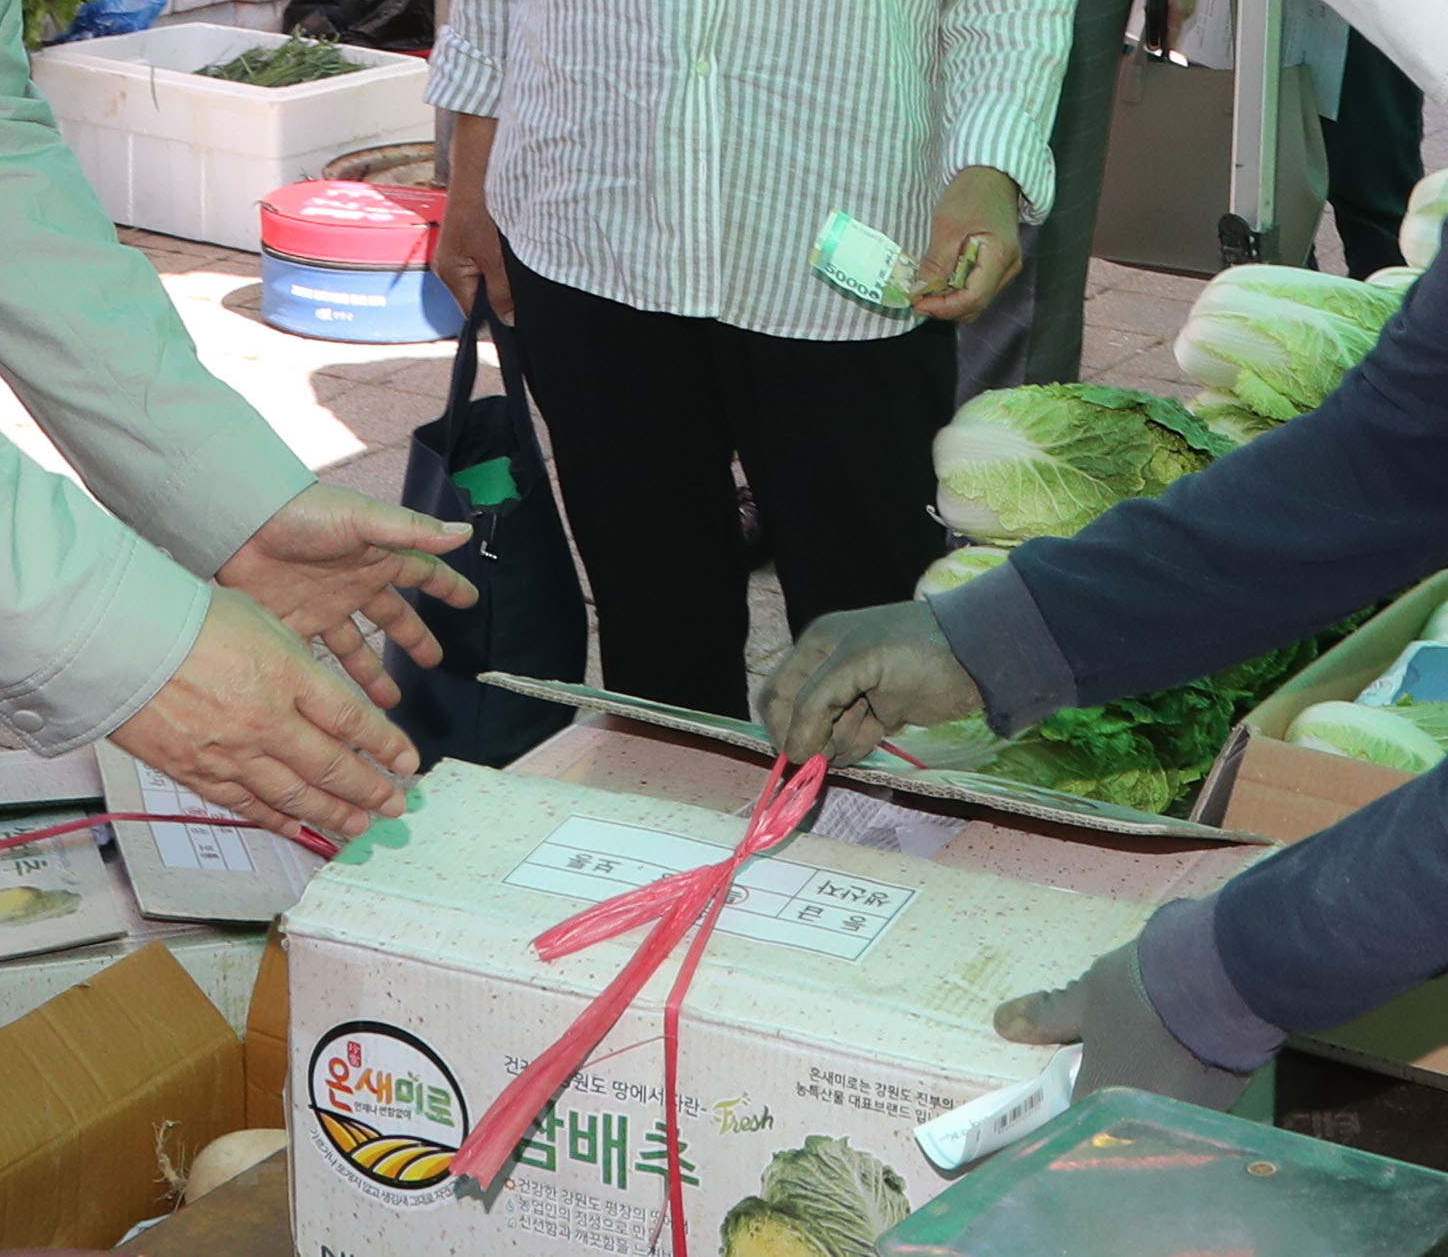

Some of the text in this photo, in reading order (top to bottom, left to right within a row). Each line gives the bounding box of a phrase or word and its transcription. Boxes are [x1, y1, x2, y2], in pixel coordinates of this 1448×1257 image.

[566, 852, 621, 874] 보통
[817, 879, 892, 909] 생산자
[325, 1057, 455, 1128] 온새미로
[561, 1070, 607, 1095] 원도
[612, 1080, 665, 1106] 땅에서
[795, 1081, 844, 1106] 농특산물
[848, 1093, 912, 1119] 대표브랜드
[808, 1066, 954, 1110] 온새미로는 강원도 진부의
[354, 1101, 412, 1121] 언제나 변함없이
[712, 1092, 774, 1135] Fresh
[518, 1177, 558, 1201] 건강한
[561, 1188, 601, 1211] 강원도
[605, 1200, 646, 1222] 평창의
[518, 1196, 571, 1222] 농업인의
[575, 1211, 630, 1236] 정성으로
[518, 1214, 572, 1240] 신선함과
[575, 1229, 631, 1256] 깨끗함을
